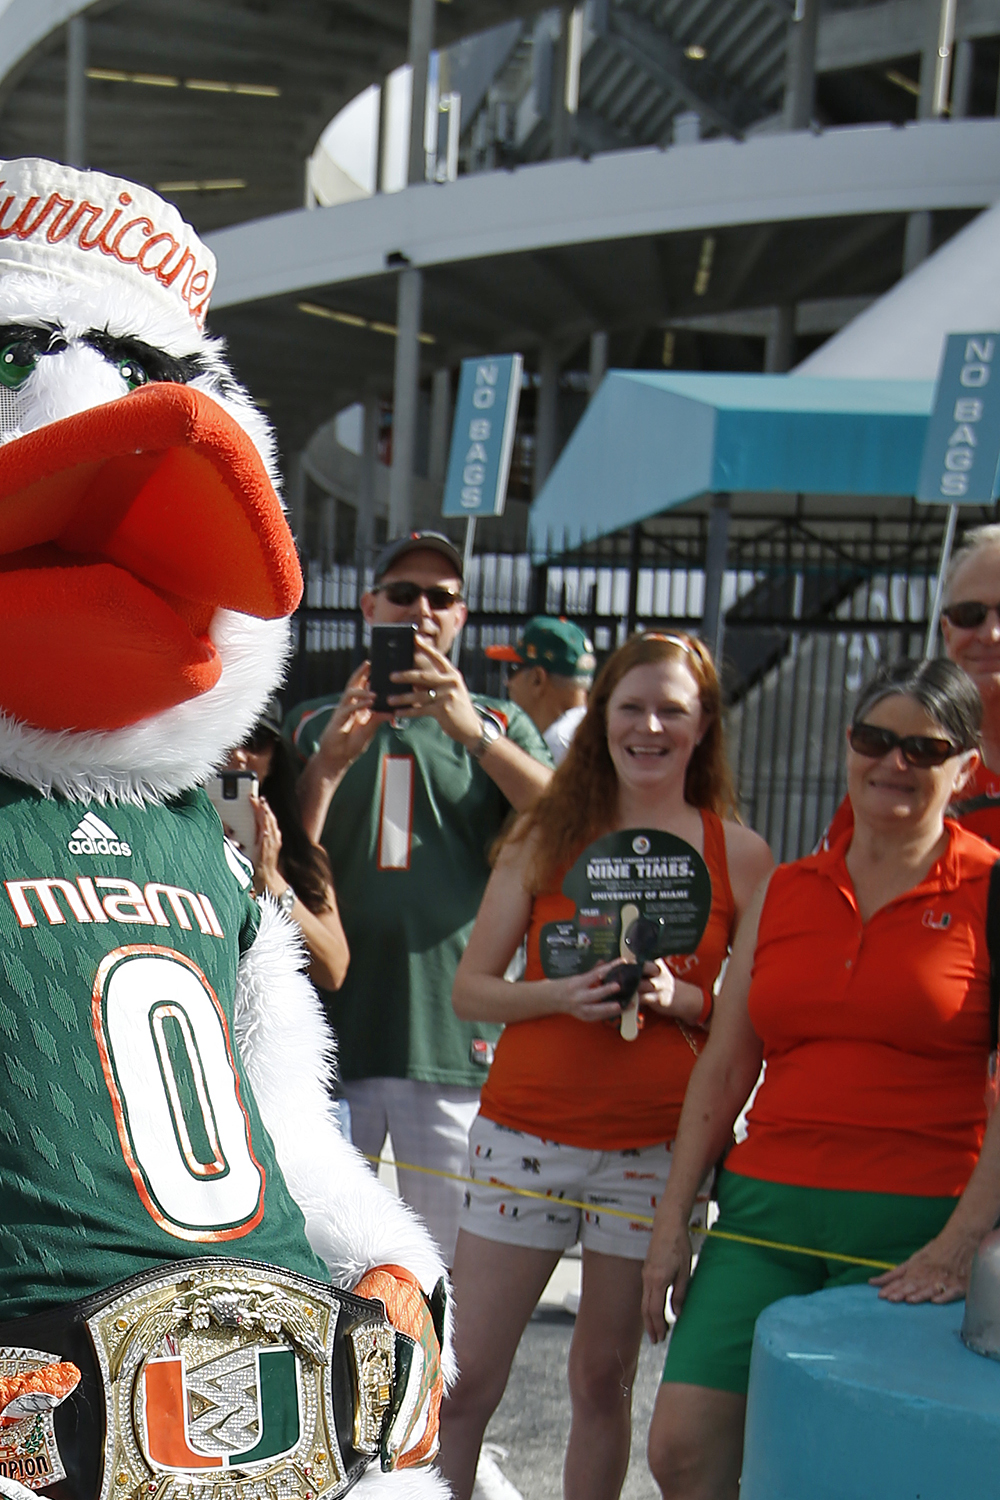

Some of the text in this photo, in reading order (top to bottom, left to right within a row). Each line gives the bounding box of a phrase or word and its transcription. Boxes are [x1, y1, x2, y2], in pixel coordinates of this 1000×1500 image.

[460, 363, 499, 508] NO BAGS
[940, 337, 995, 497] NO BAGS
[69, 838, 132, 858] adidas
[586, 861, 695, 879] NINE TIMES.
[922, 908, 951, 930] U
[92, 944, 266, 1243] 0
[142, 1344, 301, 1472] U
